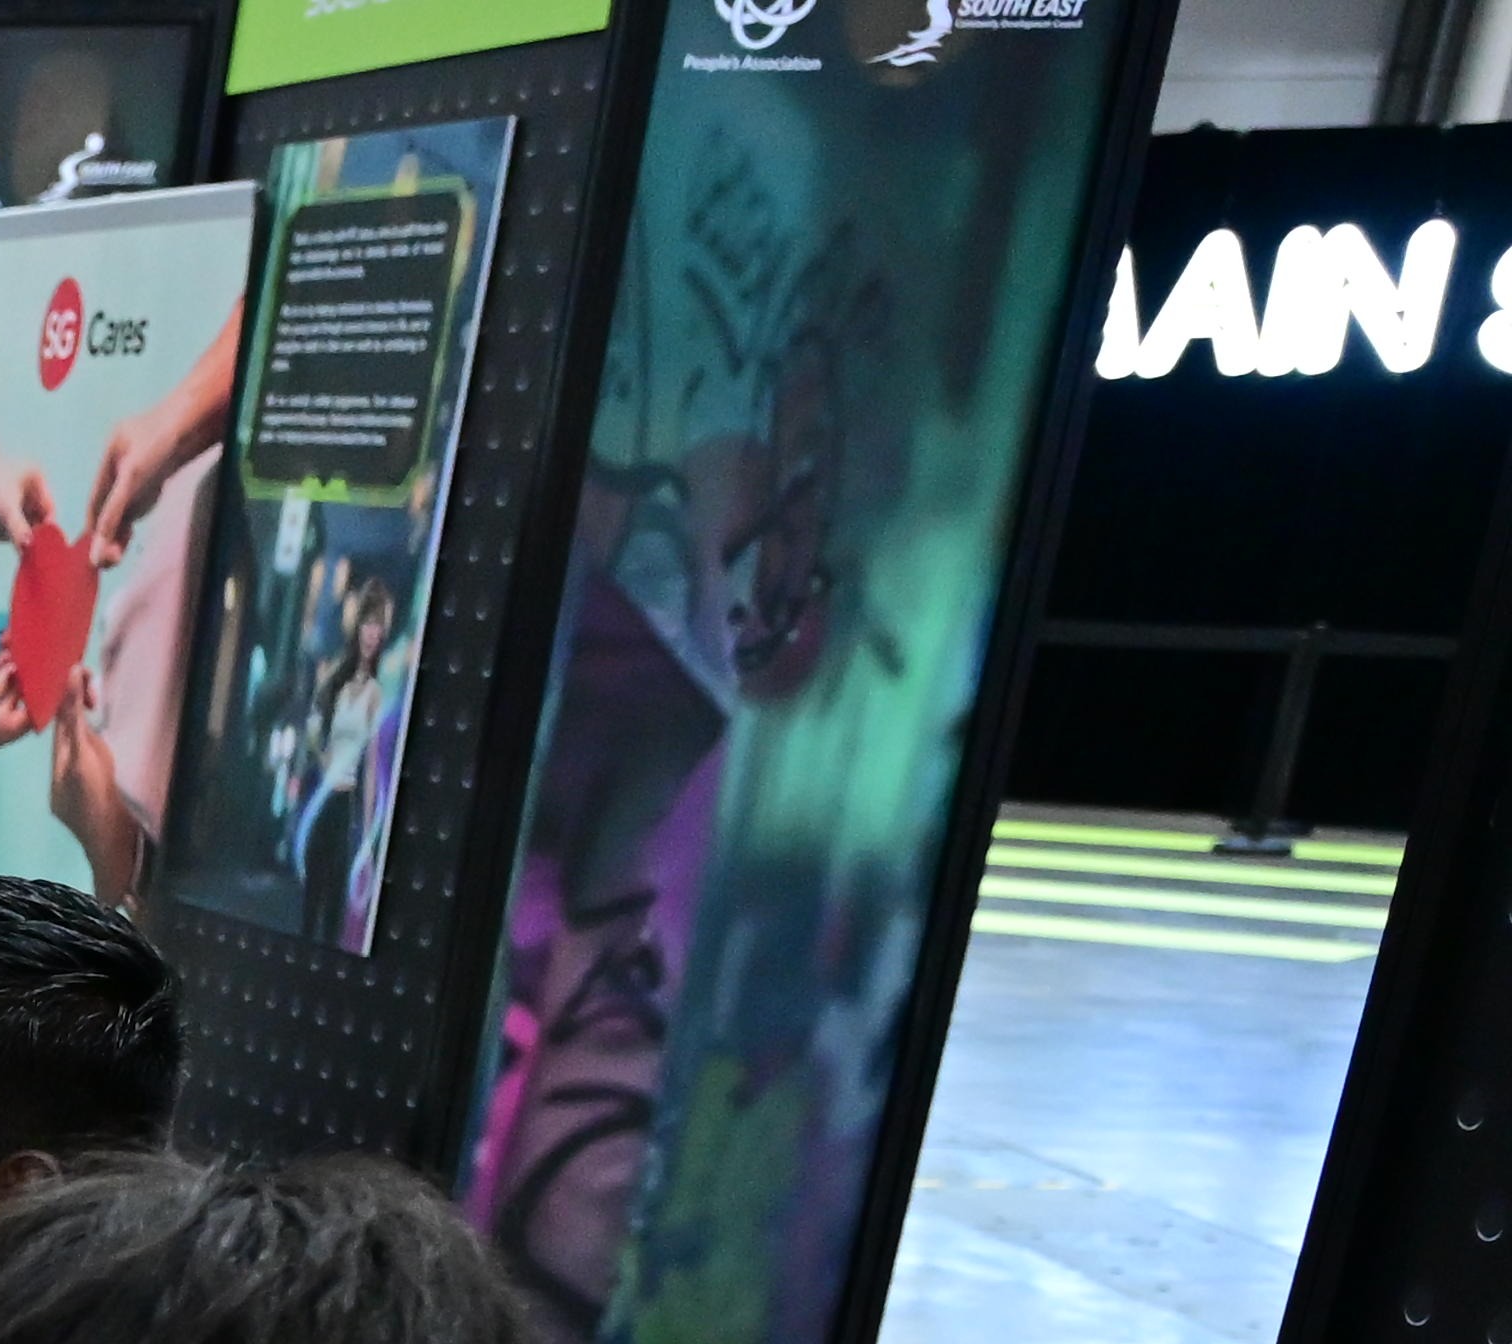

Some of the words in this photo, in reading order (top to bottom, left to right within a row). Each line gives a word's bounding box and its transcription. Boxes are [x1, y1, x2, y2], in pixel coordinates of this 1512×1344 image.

[957, 0, 1031, 17] SOUTH
[1032, 0, 1087, 17] EAST
[683, 53, 740, 74] People's
[742, 55, 822, 73] Association
[43, 310, 78, 360] SG
[87, 310, 150, 357] Cares
